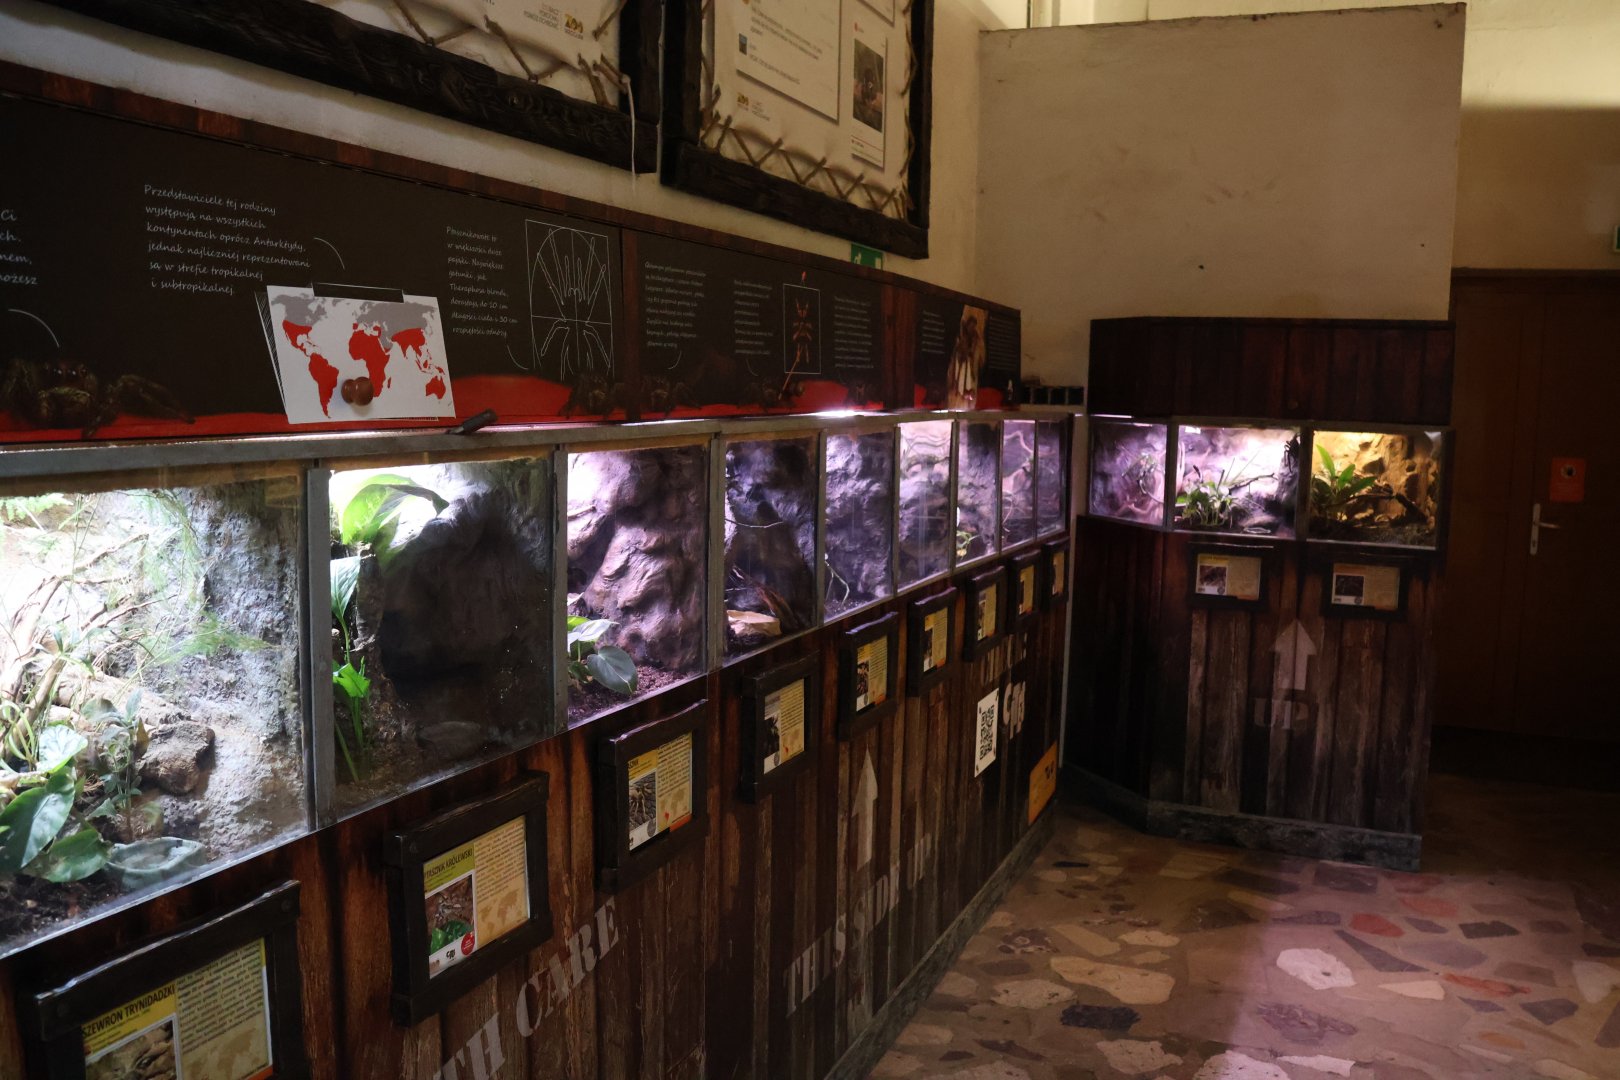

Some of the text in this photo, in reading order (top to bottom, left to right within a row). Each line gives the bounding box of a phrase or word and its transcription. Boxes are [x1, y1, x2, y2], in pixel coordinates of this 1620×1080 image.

[144, 184, 276, 217] Przedstawiciele tej rodziny
[145, 205, 267, 229] występują na wszystkich
[146, 221, 217, 240] kontynentach
[219, 232, 250, 244] oprócz
[147, 240, 311, 268] jednak najliczniej reprezentowani
[149, 261, 264, 281] są w strefie tropikalnej
[151, 277, 234, 296] i subtropikalnej
[516, 896, 619, 1038] CARE
[81, 1010, 123, 1038] SZEWRON
[124, 984, 176, 1017] TRYNIDADZKI
